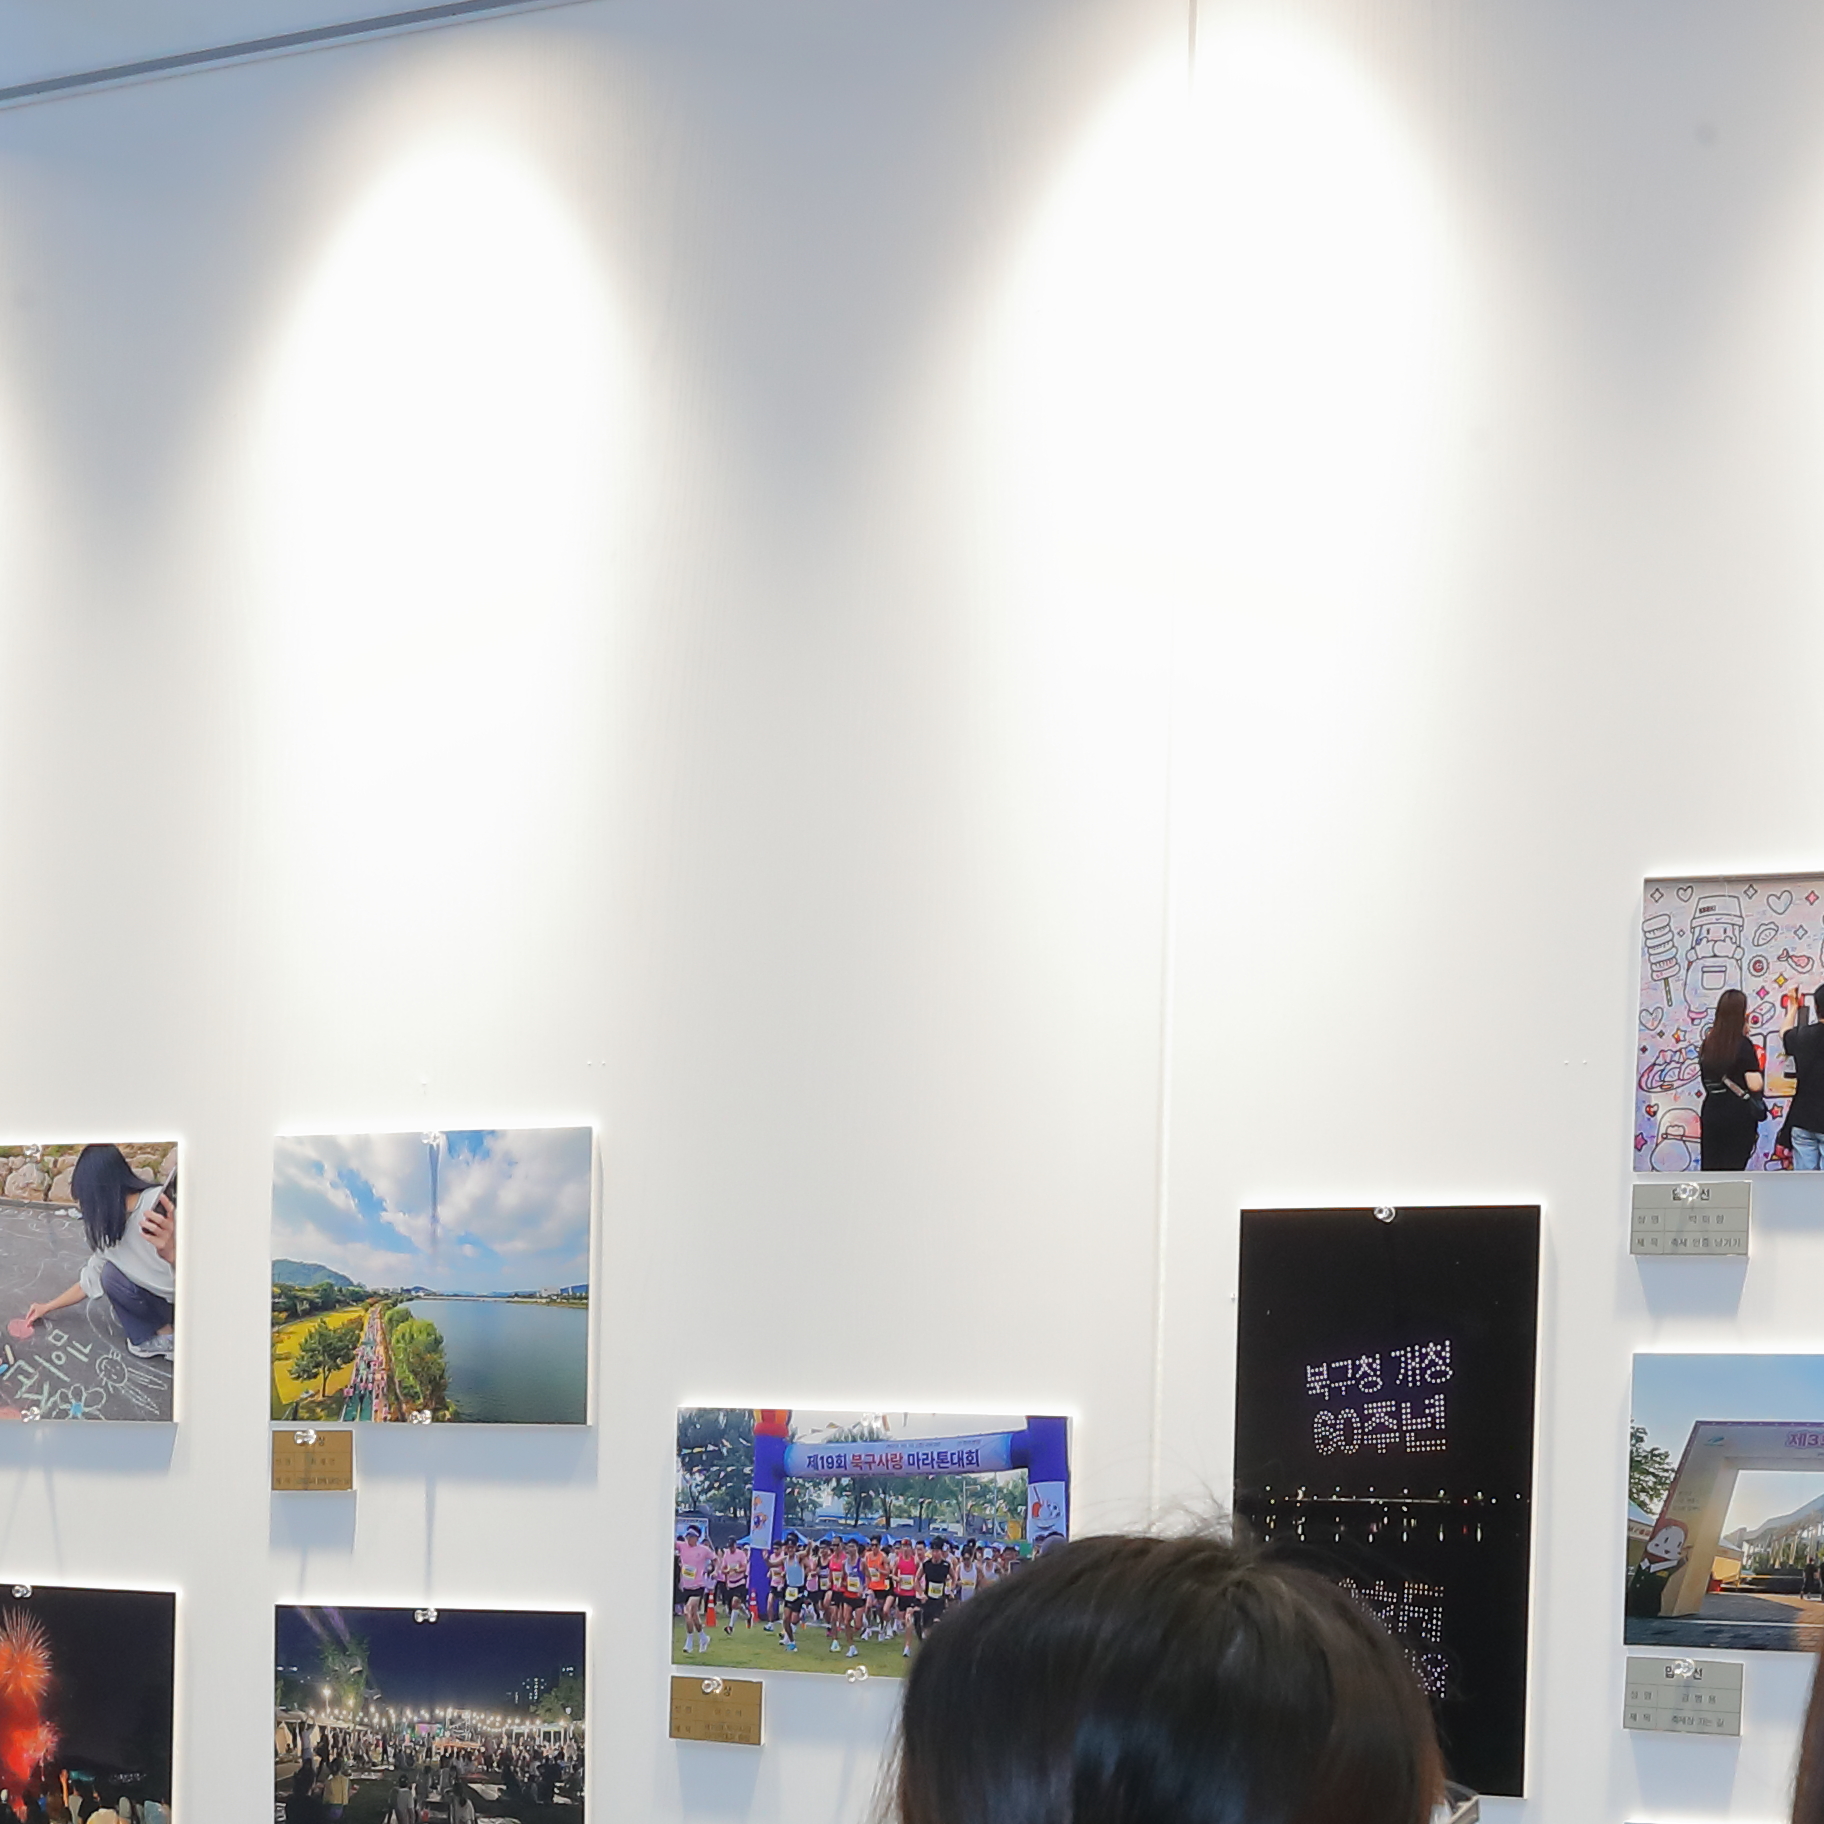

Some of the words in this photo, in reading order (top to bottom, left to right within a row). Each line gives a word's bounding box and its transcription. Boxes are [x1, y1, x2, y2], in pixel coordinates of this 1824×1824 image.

[1306, 1353, 1383, 1400] 북구청
[1390, 1339, 1455, 1388] 개청
[1313, 1393, 1446, 1456] 60주년
[806, 1453, 848, 1471] 제19회
[850, 1452, 904, 1471] 북구사랑
[907, 1449, 981, 1469] 마라톤대회
